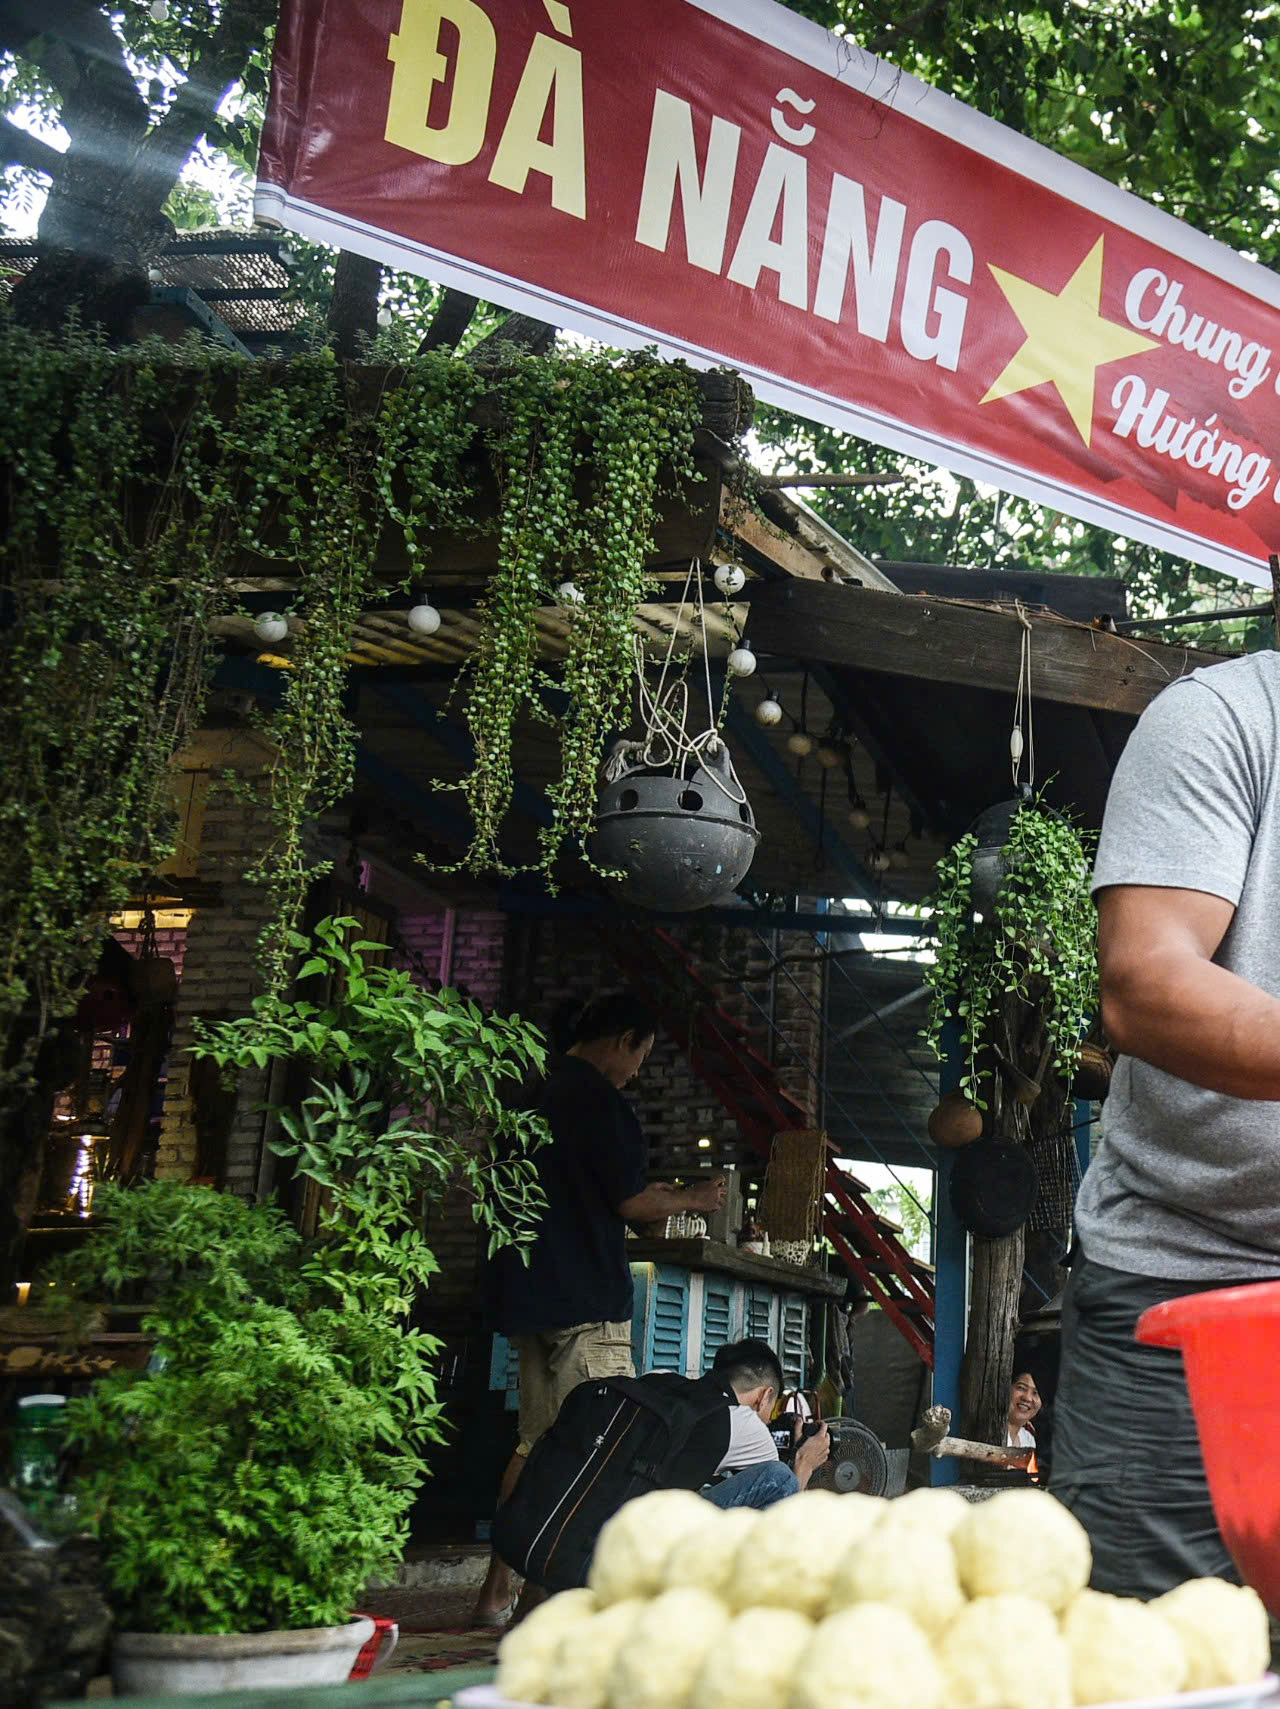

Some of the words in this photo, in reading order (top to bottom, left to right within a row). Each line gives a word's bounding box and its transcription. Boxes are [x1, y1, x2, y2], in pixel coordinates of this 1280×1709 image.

[384, 0, 587, 221] ĐÀ
[634, 87, 975, 373] NẴNG
[1124, 267, 1273, 400] Chung
[1110, 374, 1272, 511] Hướng
